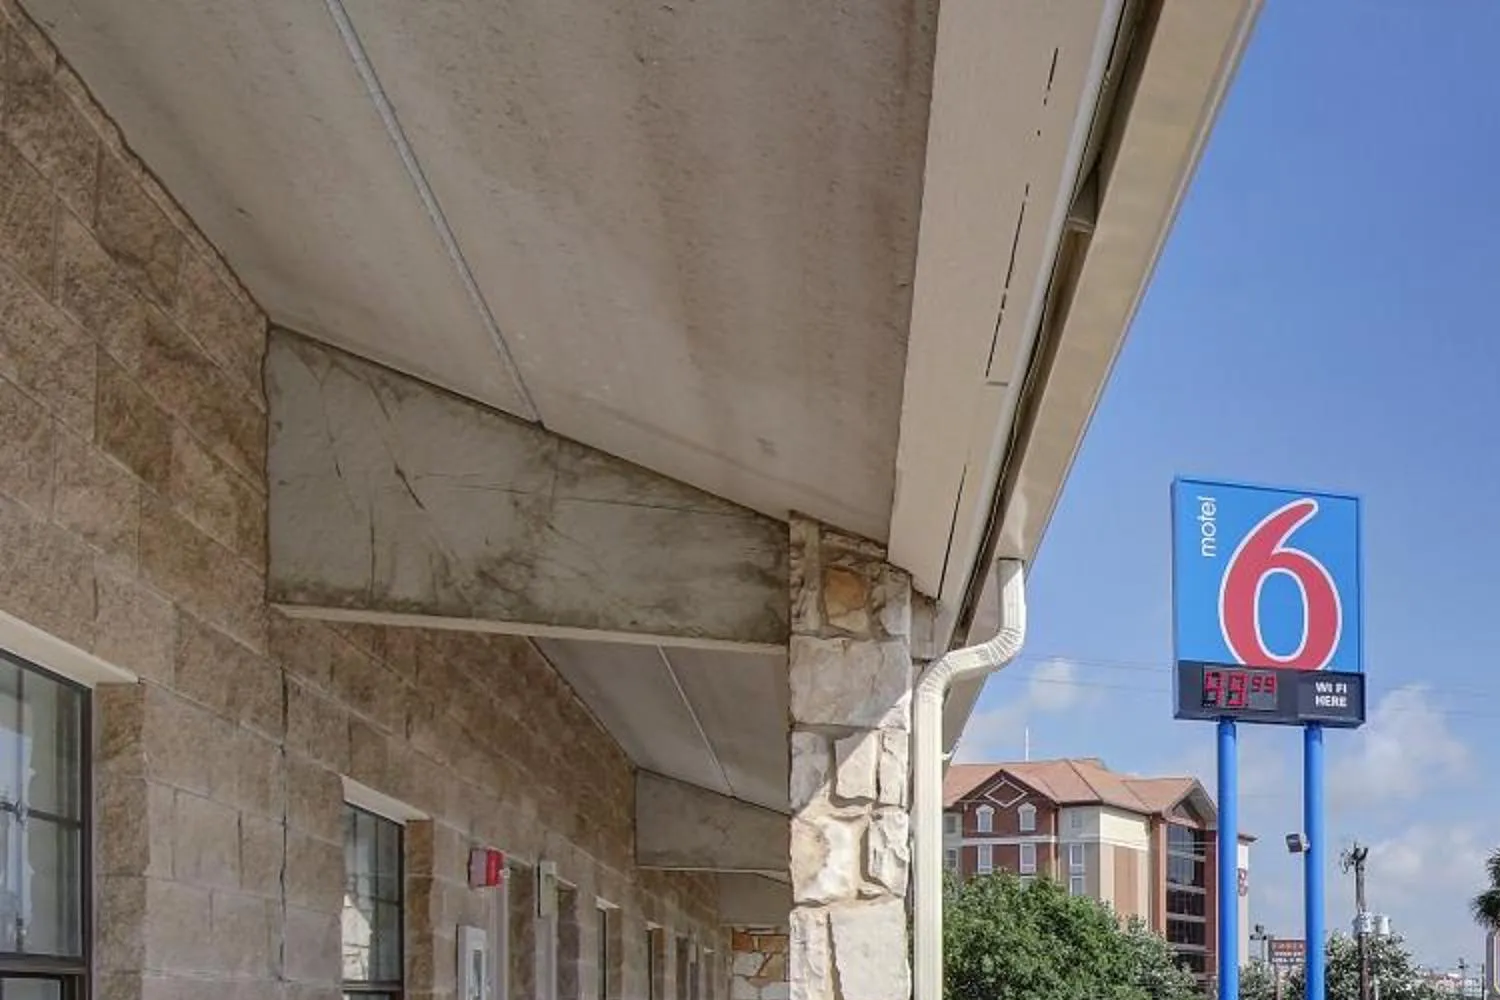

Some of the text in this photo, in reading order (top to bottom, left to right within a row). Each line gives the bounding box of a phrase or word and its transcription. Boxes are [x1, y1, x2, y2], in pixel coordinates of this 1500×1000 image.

[1197, 495, 1343, 670] motel 6
[1315, 695, 1347, 707] HERE
